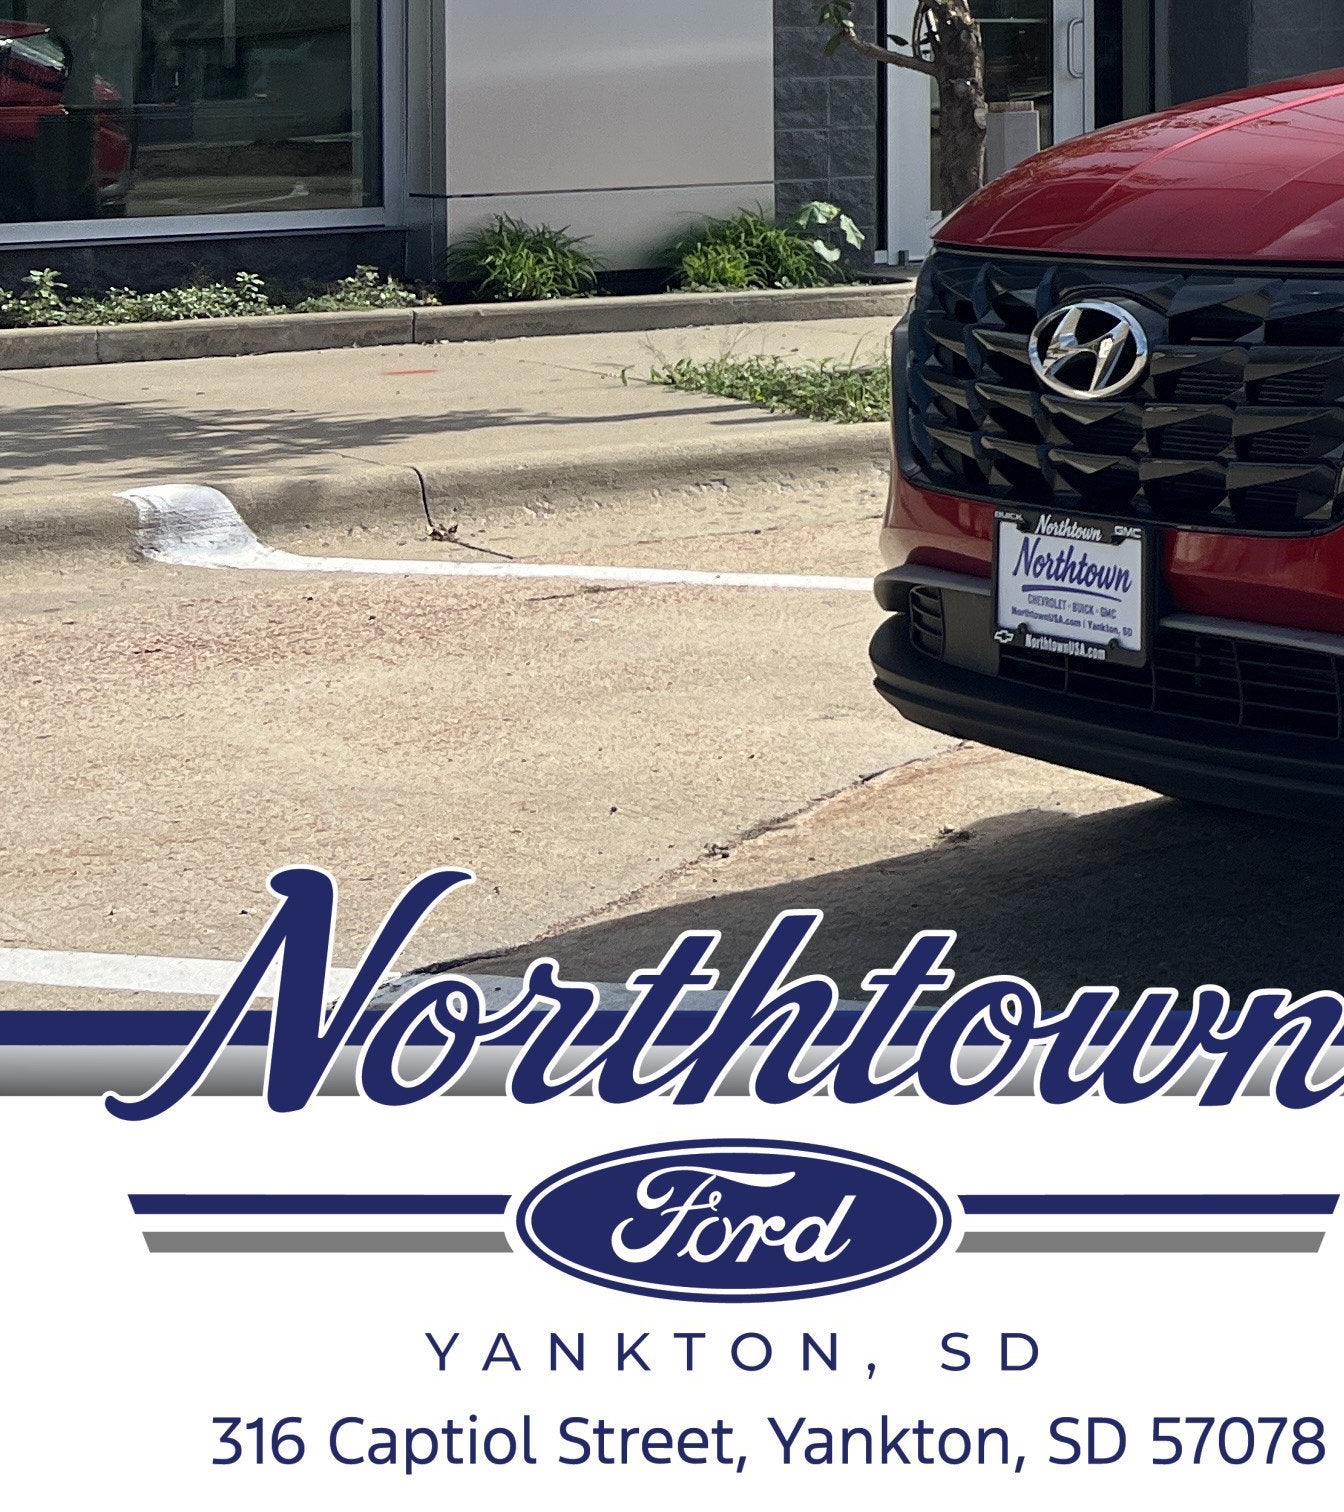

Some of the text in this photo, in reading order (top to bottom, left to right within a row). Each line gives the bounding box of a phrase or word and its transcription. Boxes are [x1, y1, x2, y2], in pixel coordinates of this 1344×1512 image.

[1035, 514, 1103, 542] Northtown
[1113, 525, 1142, 538] GMC
[1012, 537, 1133, 593] Northtown
[1027, 593, 1067, 610] CHEVROLET
[1072, 602, 1095, 616] BUICK
[1025, 634, 1106, 661] NorthtownUSA.com
